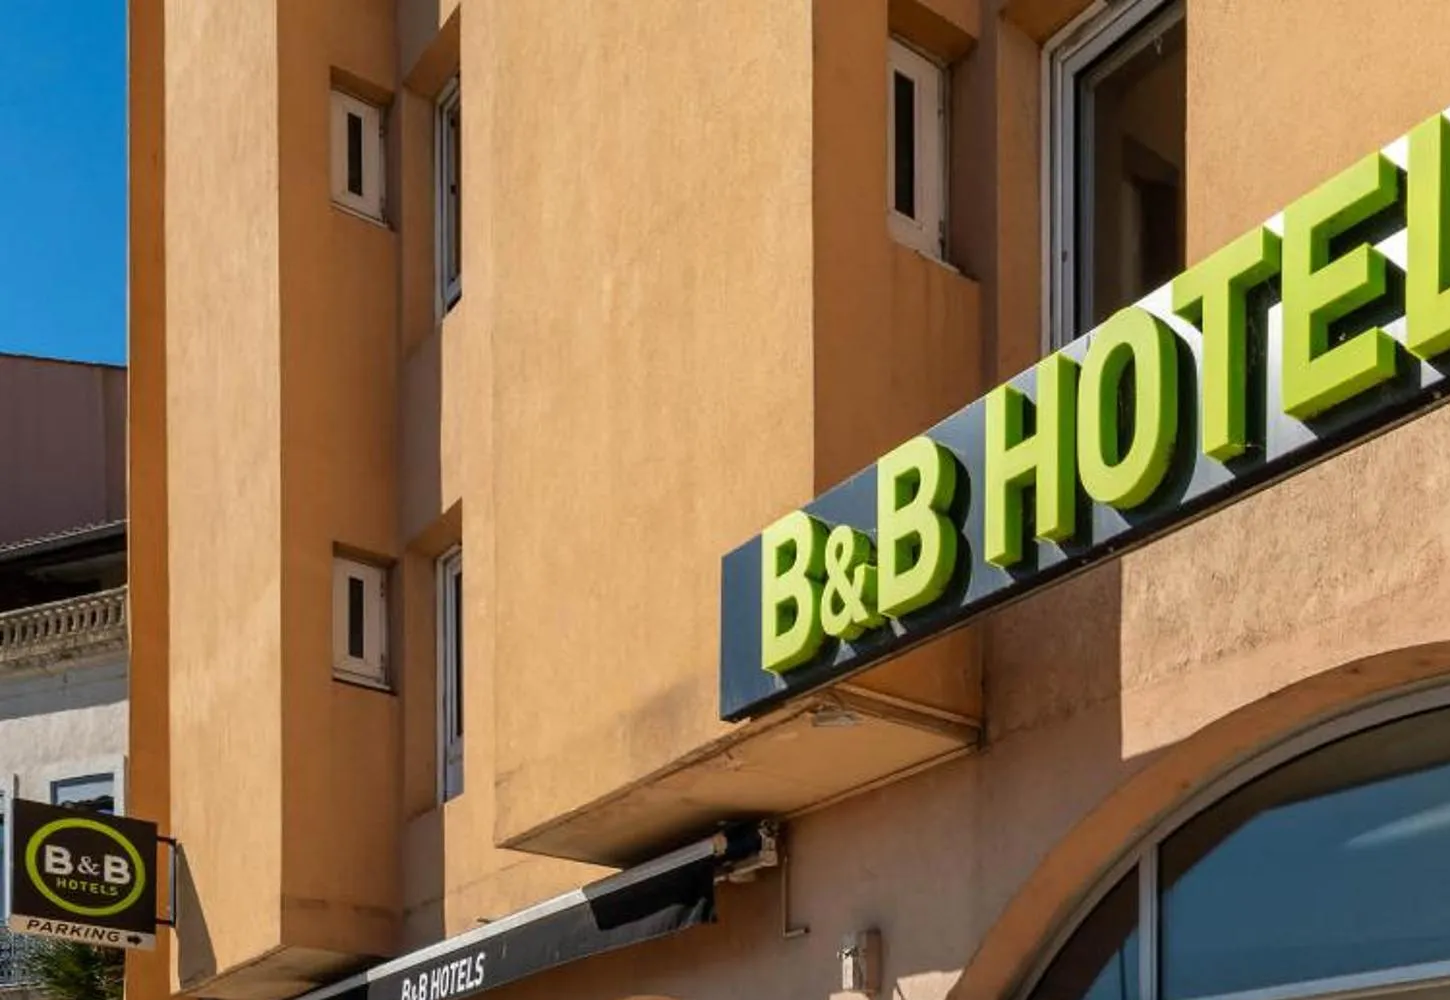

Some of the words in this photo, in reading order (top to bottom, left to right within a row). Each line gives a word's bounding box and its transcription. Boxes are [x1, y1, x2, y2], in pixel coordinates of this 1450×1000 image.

[761, 434, 962, 676] B&B
[43, 844, 131, 885] B&B
[55, 877, 119, 896] HOTELS
[26, 919, 121, 943] PARKING
[430, 952, 486, 1000] HOTELS
